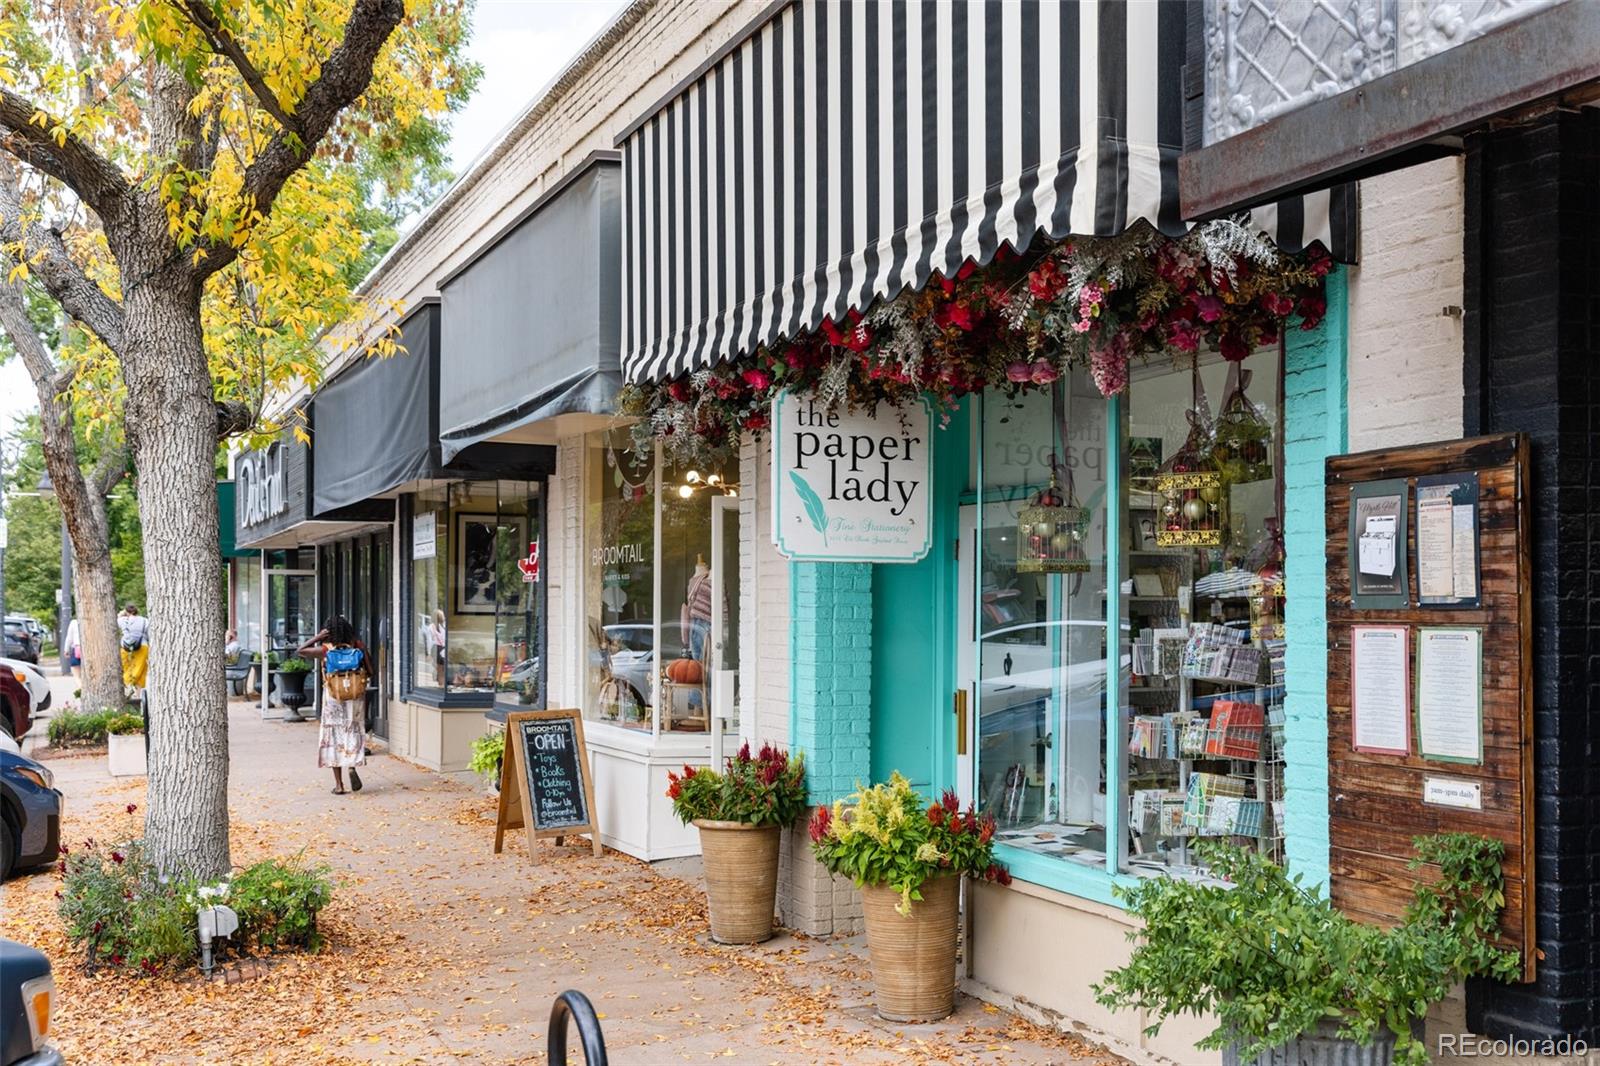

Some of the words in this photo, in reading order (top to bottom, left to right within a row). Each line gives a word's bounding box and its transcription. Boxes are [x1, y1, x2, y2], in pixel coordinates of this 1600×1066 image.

[796, 400, 840, 428] the
[793, 431, 921, 472] paper
[827, 459, 920, 516] lady
[592, 543, 645, 566] BROOMTAIL
[526, 725, 569, 734] BROOMTAIL
[535, 733, 565, 750] OPEN
[537, 752, 557, 766] Toys
